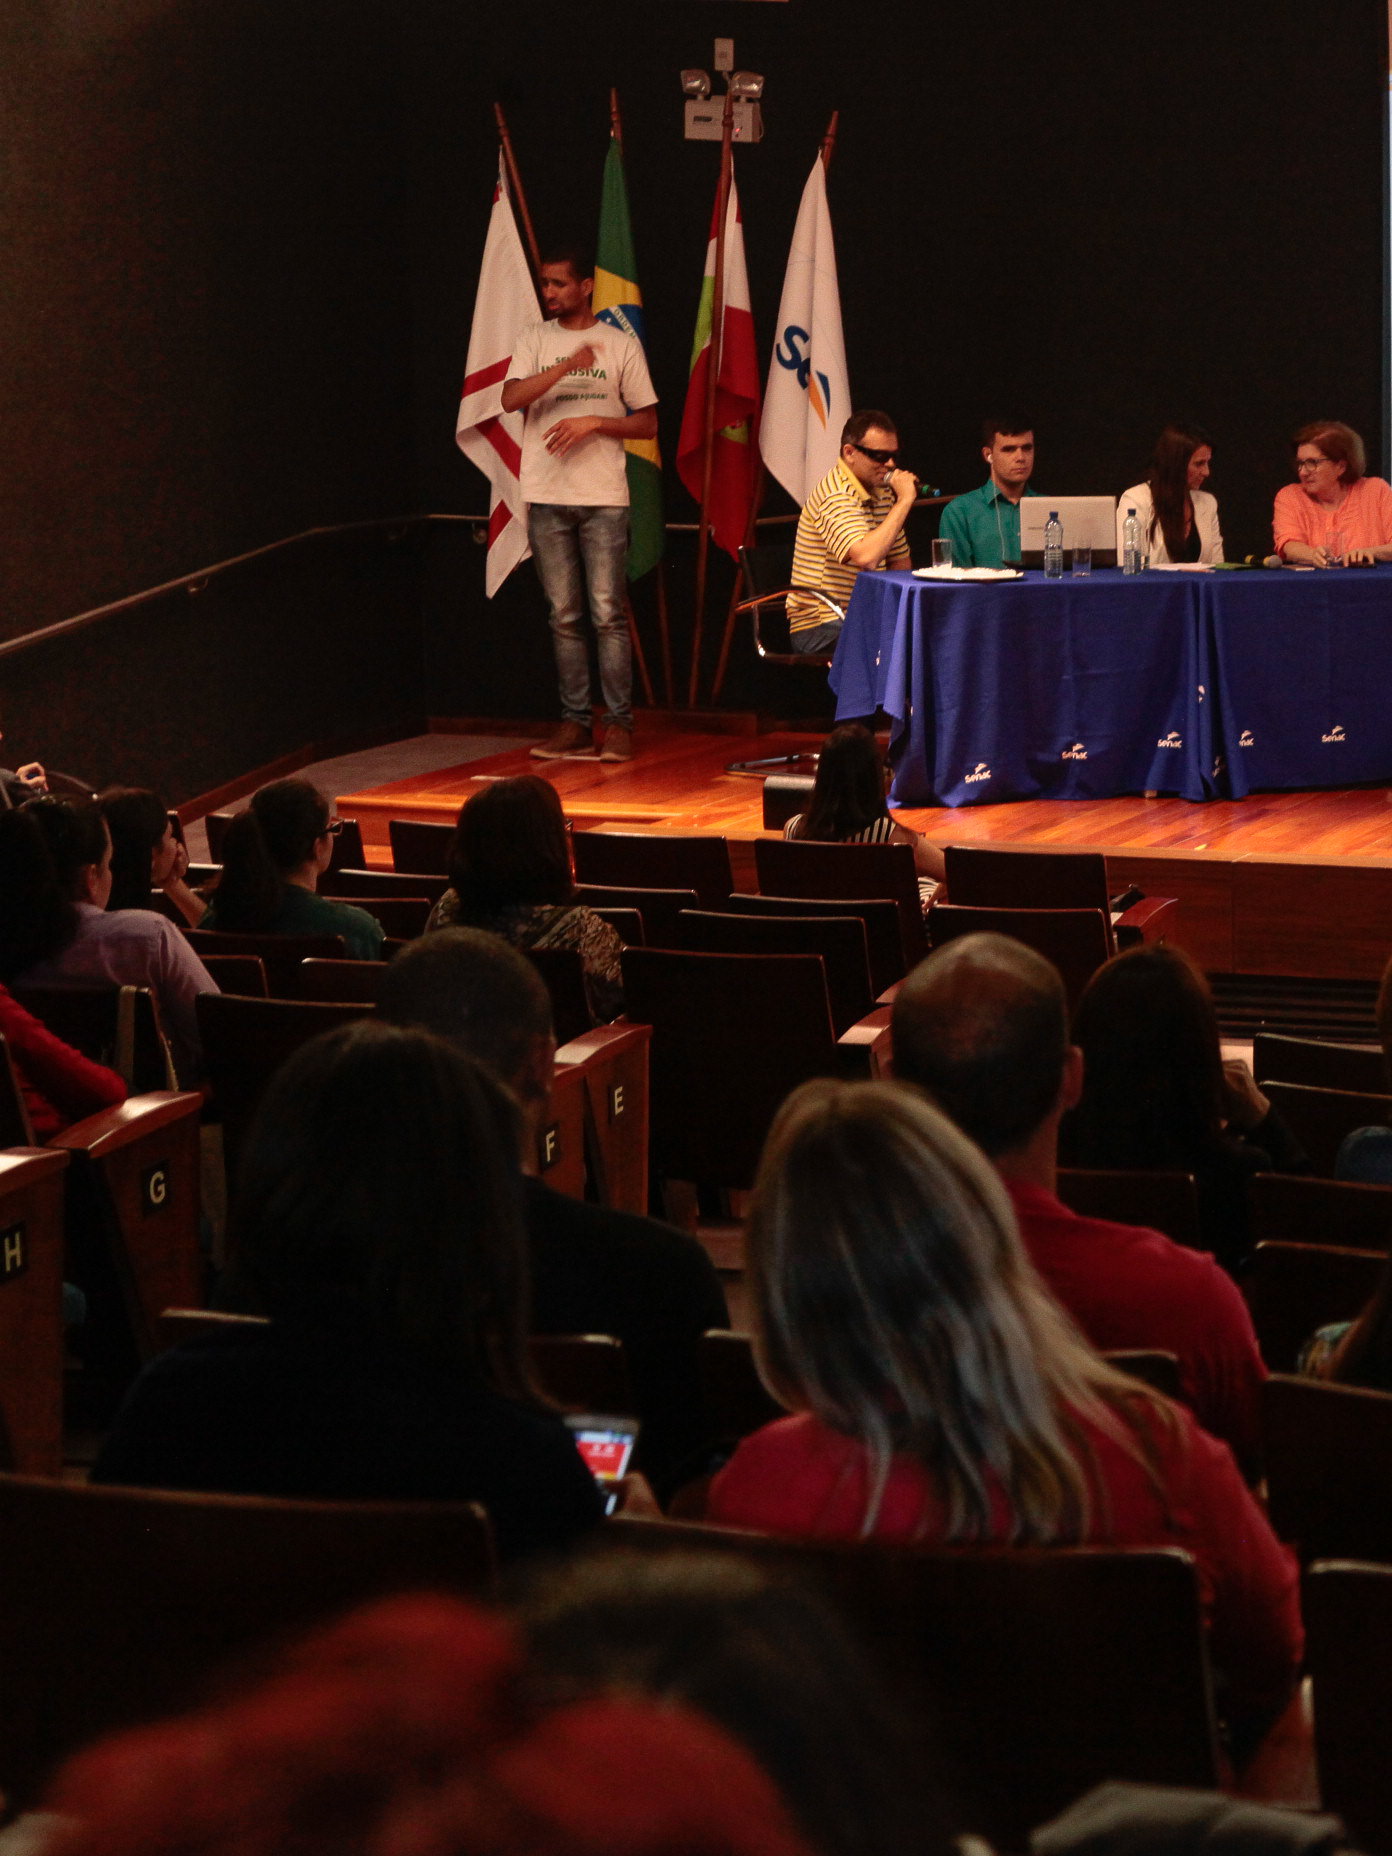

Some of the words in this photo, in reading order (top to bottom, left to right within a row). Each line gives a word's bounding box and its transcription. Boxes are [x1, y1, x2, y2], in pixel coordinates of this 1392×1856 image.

[613, 1086, 625, 1116] E
[544, 1129, 557, 1163] F
[148, 1170, 167, 1206] G
[3, 1232, 22, 1273] H
